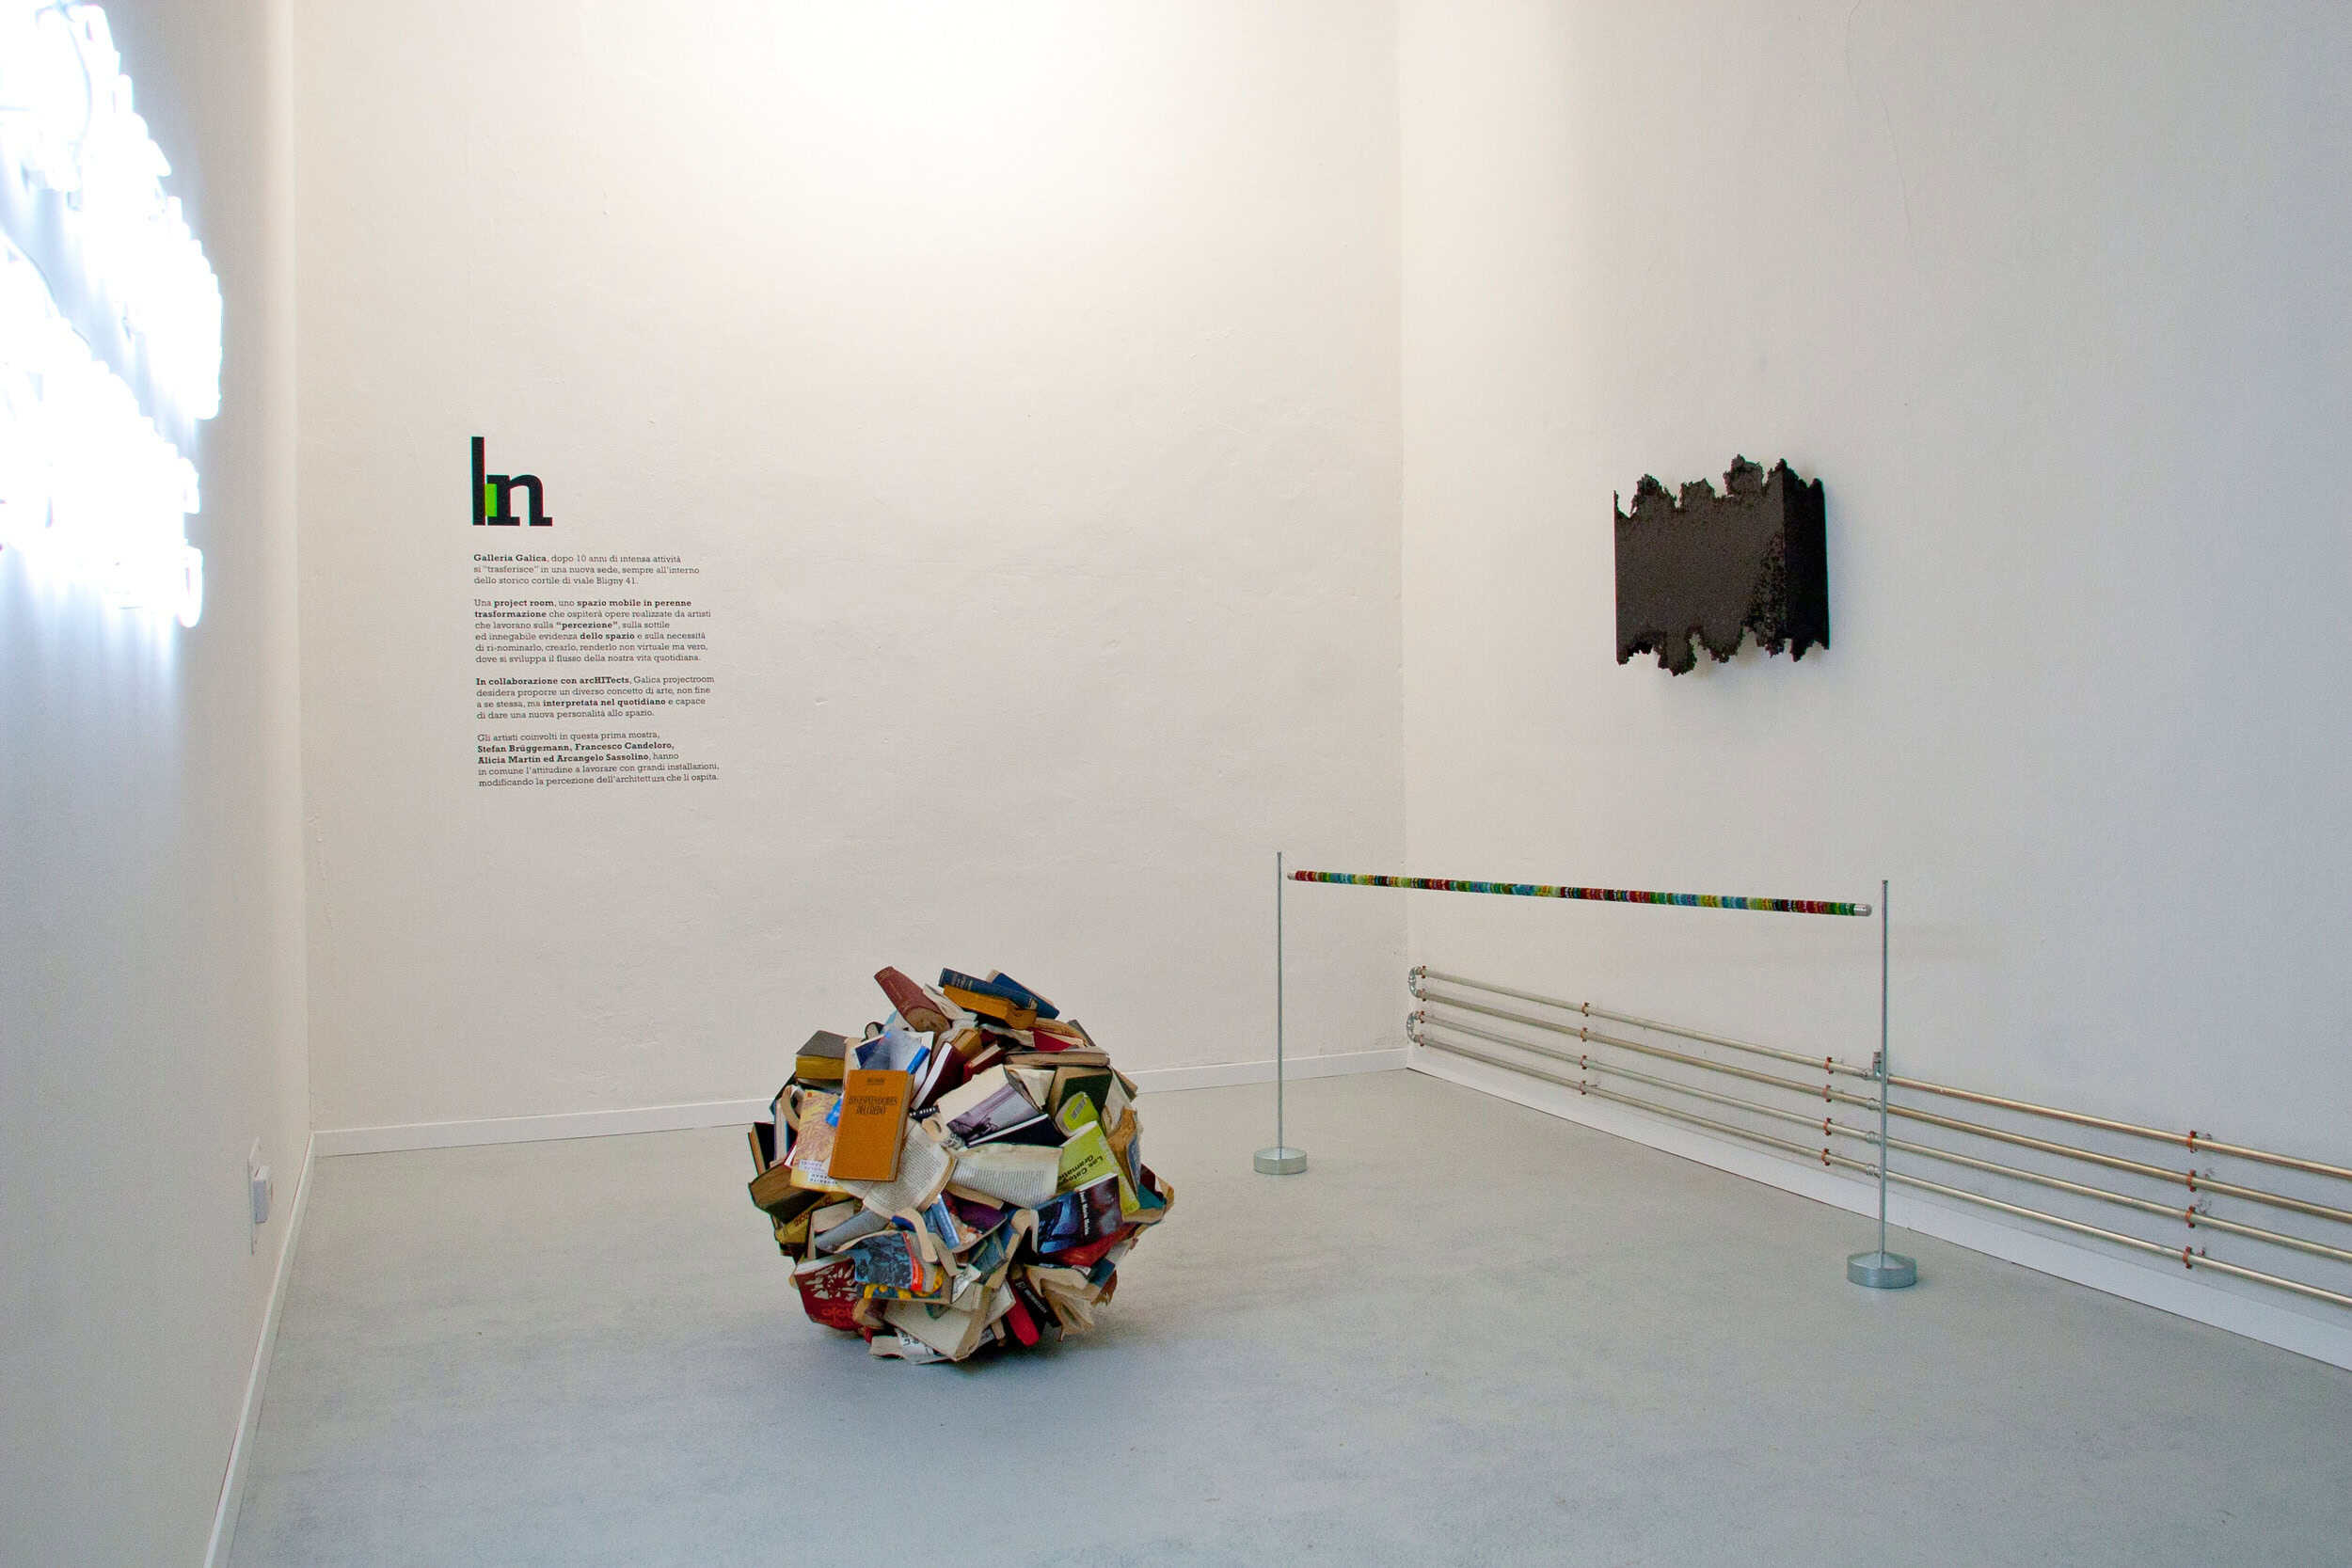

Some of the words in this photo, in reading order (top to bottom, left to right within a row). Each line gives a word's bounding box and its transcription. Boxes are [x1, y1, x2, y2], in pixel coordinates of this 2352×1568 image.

[516, 554, 549, 563] Galica,
[551, 554, 574, 563] dopo
[597, 565, 620, 574] sede,
[596, 577, 623, 586] Bligny
[494, 599, 527, 609] project
[577, 599, 606, 609] spazio
[567, 610, 602, 619] ospiterà
[488, 633, 536, 641] innegabile
[606, 632, 635, 641] spazio
[509, 655, 547, 664] sviluppa
[584, 654, 605, 662] della
[488, 676, 558, 685] collaborazione
[476, 689, 515, 697] desidera
[543, 700, 598, 708] interpretata
[617, 698, 666, 707] quotidiano
[557, 709, 605, 720] personalità
[520, 732, 557, 740] coinvolti
[570, 733, 599, 741] questa
[600, 733, 627, 741] prima
[509, 745, 572, 753] Brüggemann,
[625, 741, 675, 750] Candeloro,
[557, 753, 604, 763] Arcangelo
[637, 764, 665, 773] grandi
[479, 777, 533, 786] modificando
[546, 778, 595, 786] percezione
